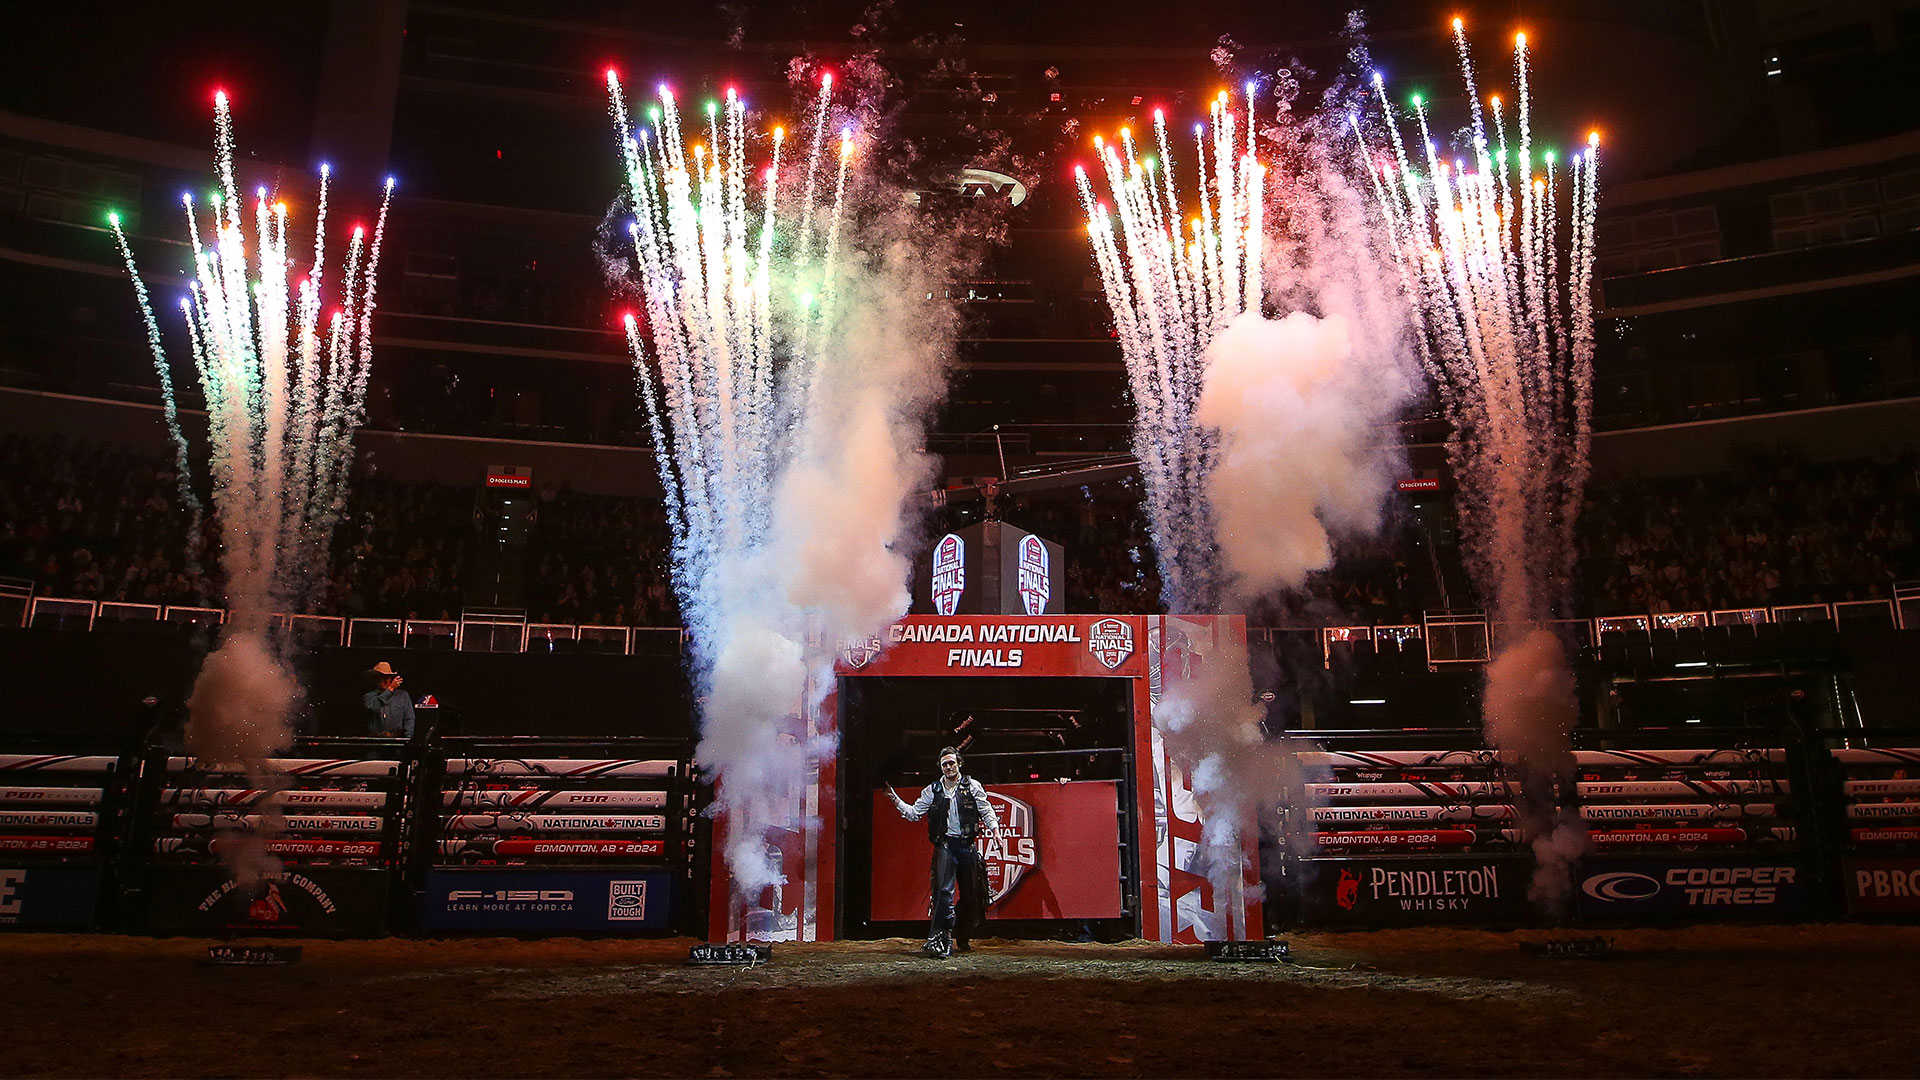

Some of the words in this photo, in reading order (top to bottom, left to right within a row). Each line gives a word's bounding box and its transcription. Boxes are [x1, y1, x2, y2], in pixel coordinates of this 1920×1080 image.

[931, 567, 964, 600] FINALS
[1018, 568, 1050, 601] FINALS
[888, 624, 974, 643] CANADA
[979, 624, 1081, 643] NATIONAL
[1088, 639, 1134, 652] FINALS
[946, 648, 1022, 668] FINALS
[1314, 787, 1352, 795] PBR
[1586, 785, 1624, 793] PBR
[569, 795, 609, 803] PBR
[1314, 810, 1375, 820] NATIONAL
[1383, 810, 1428, 819] FINALS
[1586, 809, 1646, 818] NATIONAL
[1654, 808, 1699, 817] FINALS
[47, 816, 94, 825] FINALS
[330, 820, 377, 829] FINALS
[542, 818, 606, 828] NATIONAL
[614, 818, 661, 828] FINALS
[1318, 835, 1382, 845] EDMONTON,
[1382, 835, 1399, 844] AB
[1407, 834, 1438, 844] 2024
[1655, 833, 1670, 841] AB
[1679, 832, 1709, 841] 2024
[316, 845, 333, 853] AB
[342, 845, 375, 854] 2024
[534, 844, 599, 853] EDMONTON,
[600, 844, 616, 853] AB
[626, 844, 658, 853] 2024
[1665, 867, 1797, 886] COOPER
[1369, 865, 1500, 900] PENDLETON
[196, 889, 222, 912] THE
[292, 873, 337, 915] COMPANY
[448, 889, 575, 901] F-150
[613, 884, 643, 896] BUILT
[1684, 887, 1777, 905] TIRES
[447, 904, 478, 912] LEARN
[484, 904, 510, 912] MORE
[514, 904, 527, 912] AT
[530, 904, 574, 912] FORD.CA
[1400, 898, 1470, 911] WHISKY
[612, 907, 642, 917] TOUGH
